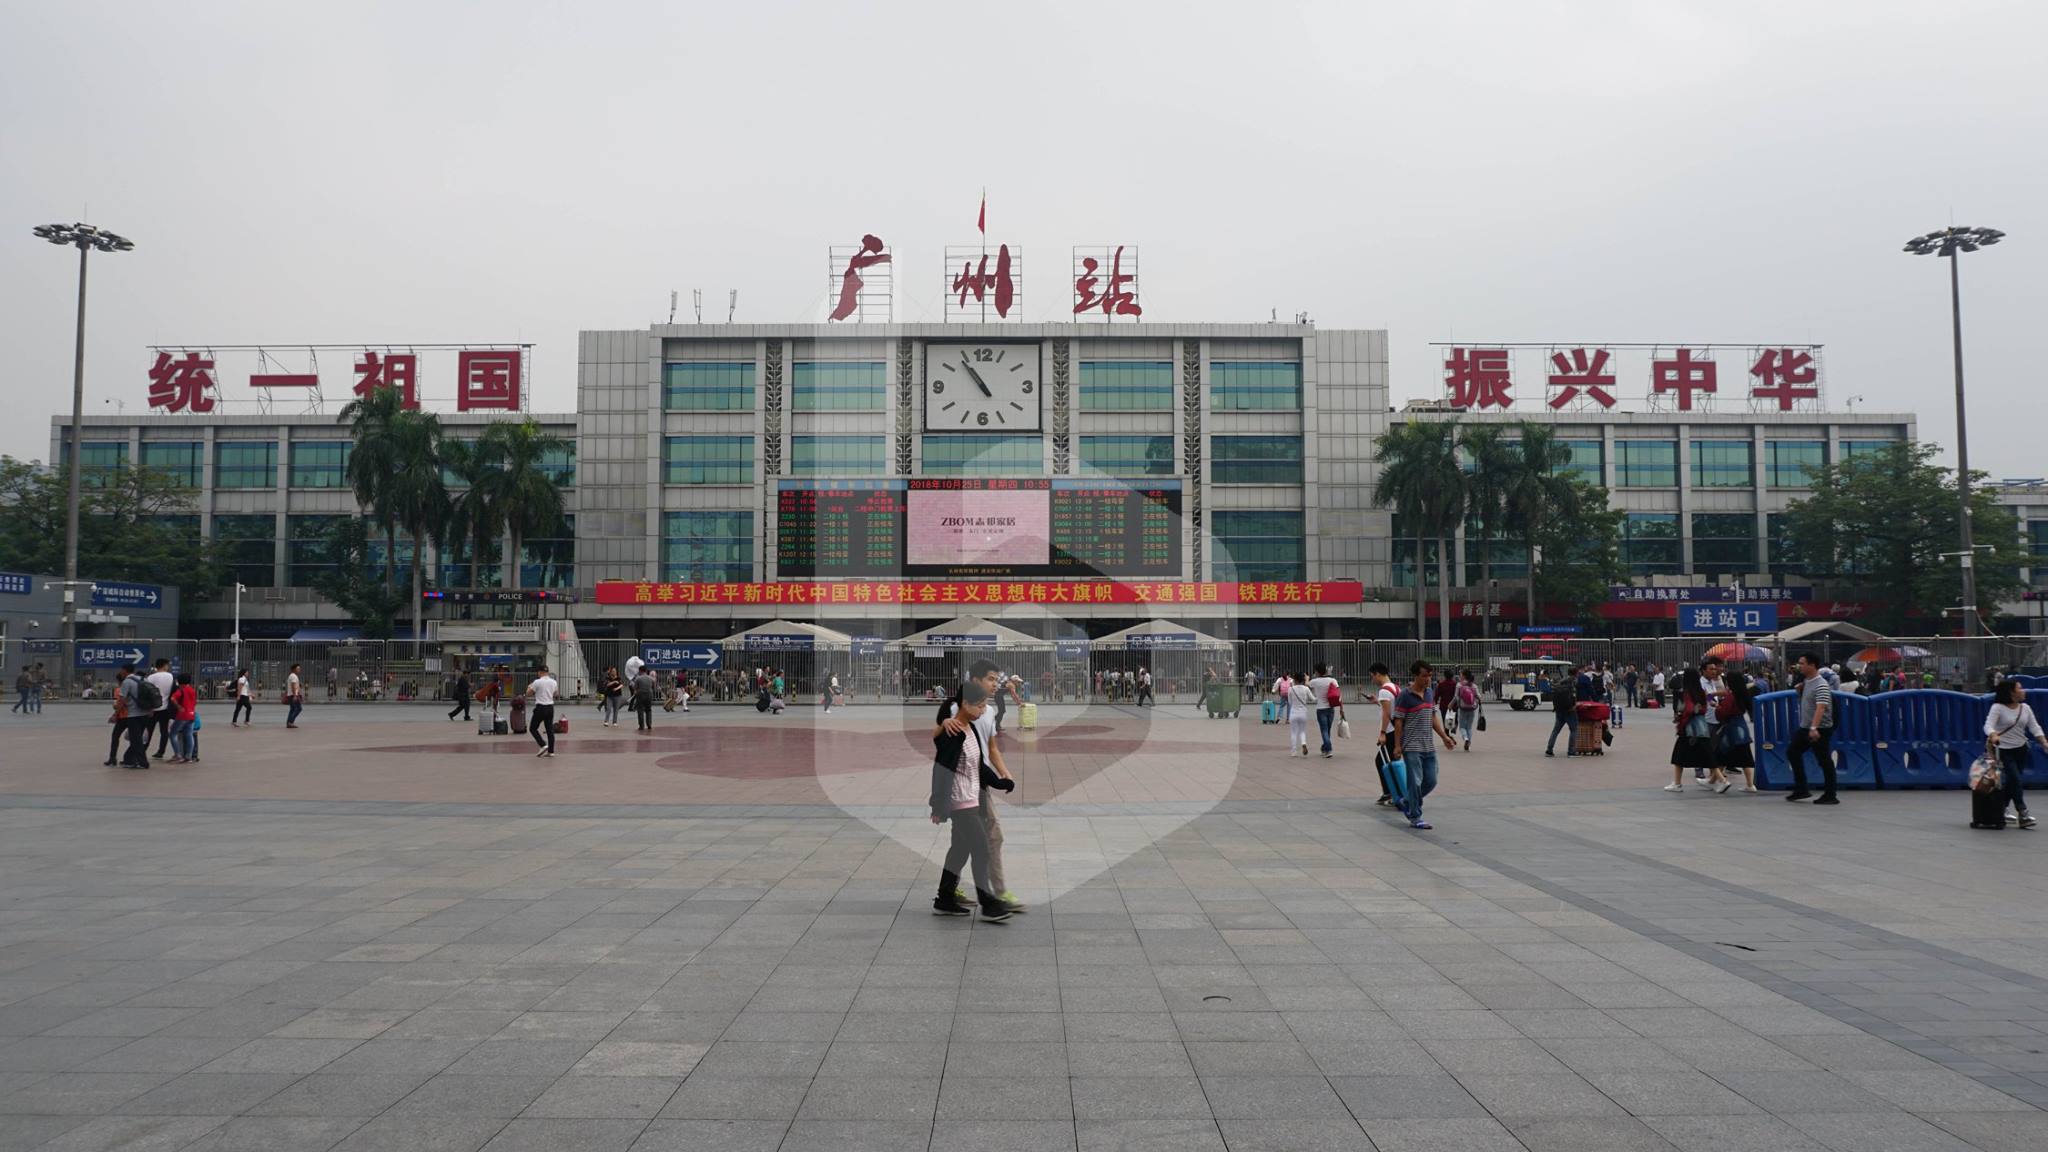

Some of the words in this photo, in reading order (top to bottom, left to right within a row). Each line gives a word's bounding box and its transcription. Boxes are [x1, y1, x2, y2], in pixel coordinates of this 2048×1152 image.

[828, 234, 1142, 321] 广州站
[973, 348, 993, 363] 12
[147, 350, 522, 413] 统一祖国
[1444, 347, 1819, 411] 振兴中华
[932, 380, 945, 394] 9
[1022, 380, 1033, 394] 3
[976, 412, 988, 425] 6
[1024, 480, 1049, 489] 10:55
[941, 517, 974, 526] ZBOM
[635, 583, 1112, 602] 高举习近平新时代中国特色社会主义思想伟大旗帜
[1135, 583, 1218, 602] 交通强国
[1239, 583, 1323, 602] 铁路先行
[1694, 608, 1762, 628] 进站口
[96, 648, 124, 659] 进站口
[662, 649, 690, 660] 进站口
